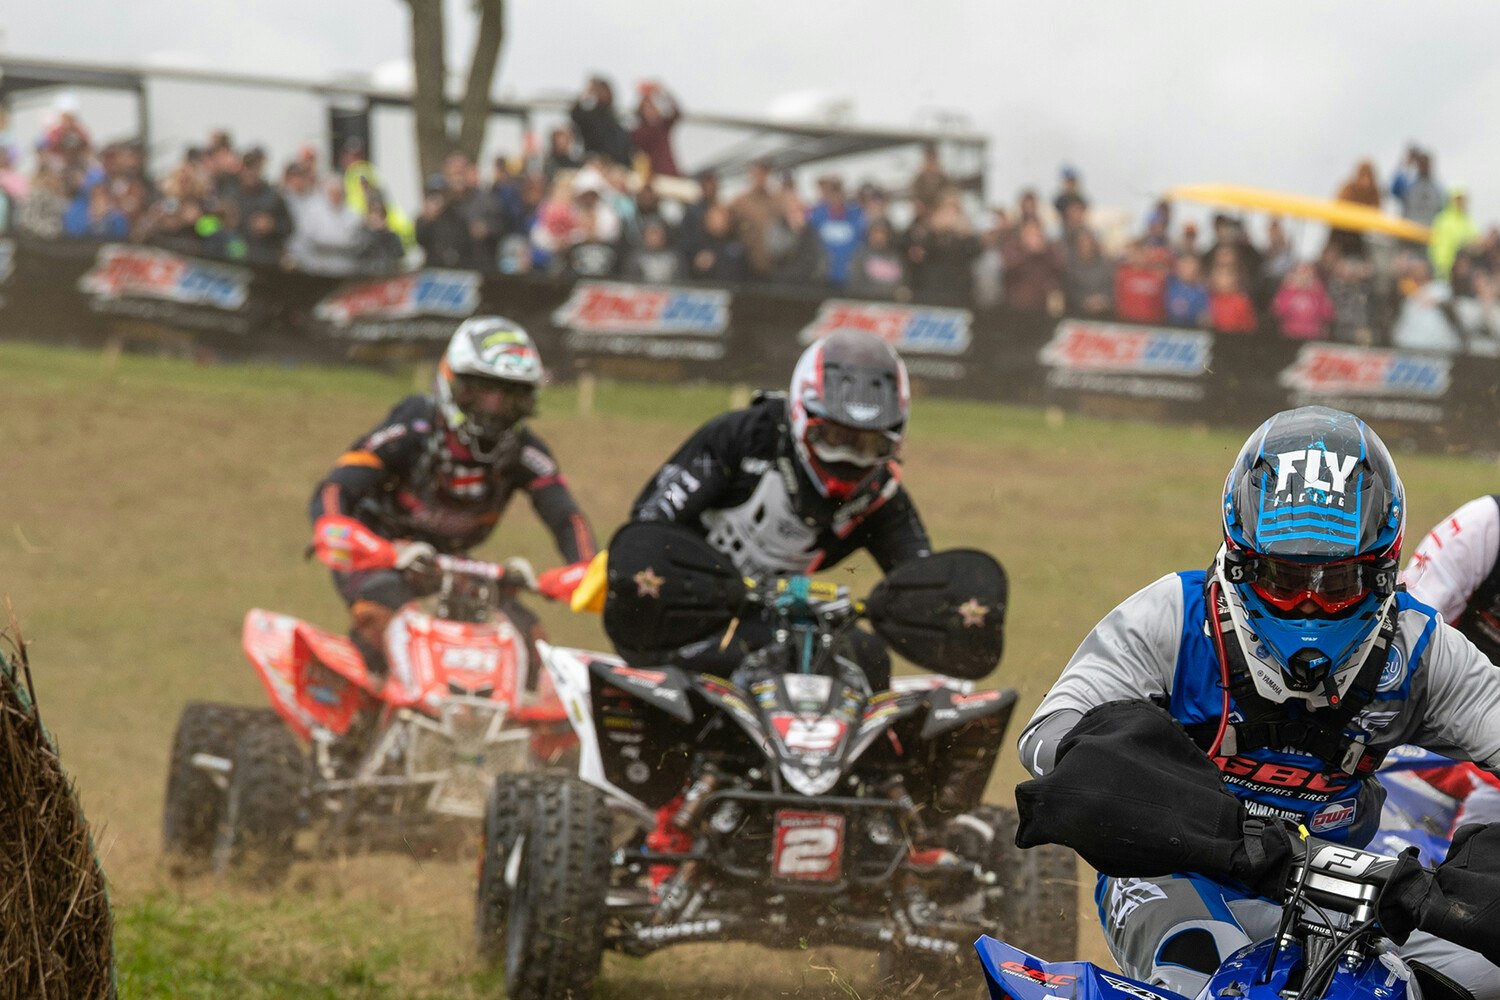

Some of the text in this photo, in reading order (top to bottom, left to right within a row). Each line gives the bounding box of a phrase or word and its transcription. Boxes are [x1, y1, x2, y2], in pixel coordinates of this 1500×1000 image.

[1275, 449, 1358, 494] FLY
[1262, 674, 1283, 696] YAMAHA
[785, 720, 840, 748] 2
[1223, 774, 1330, 803] OWERSPORTS TIRES
[778, 828, 838, 874] 2
[1307, 921, 1348, 939] HOUSR
[999, 961, 1078, 986] GBC
